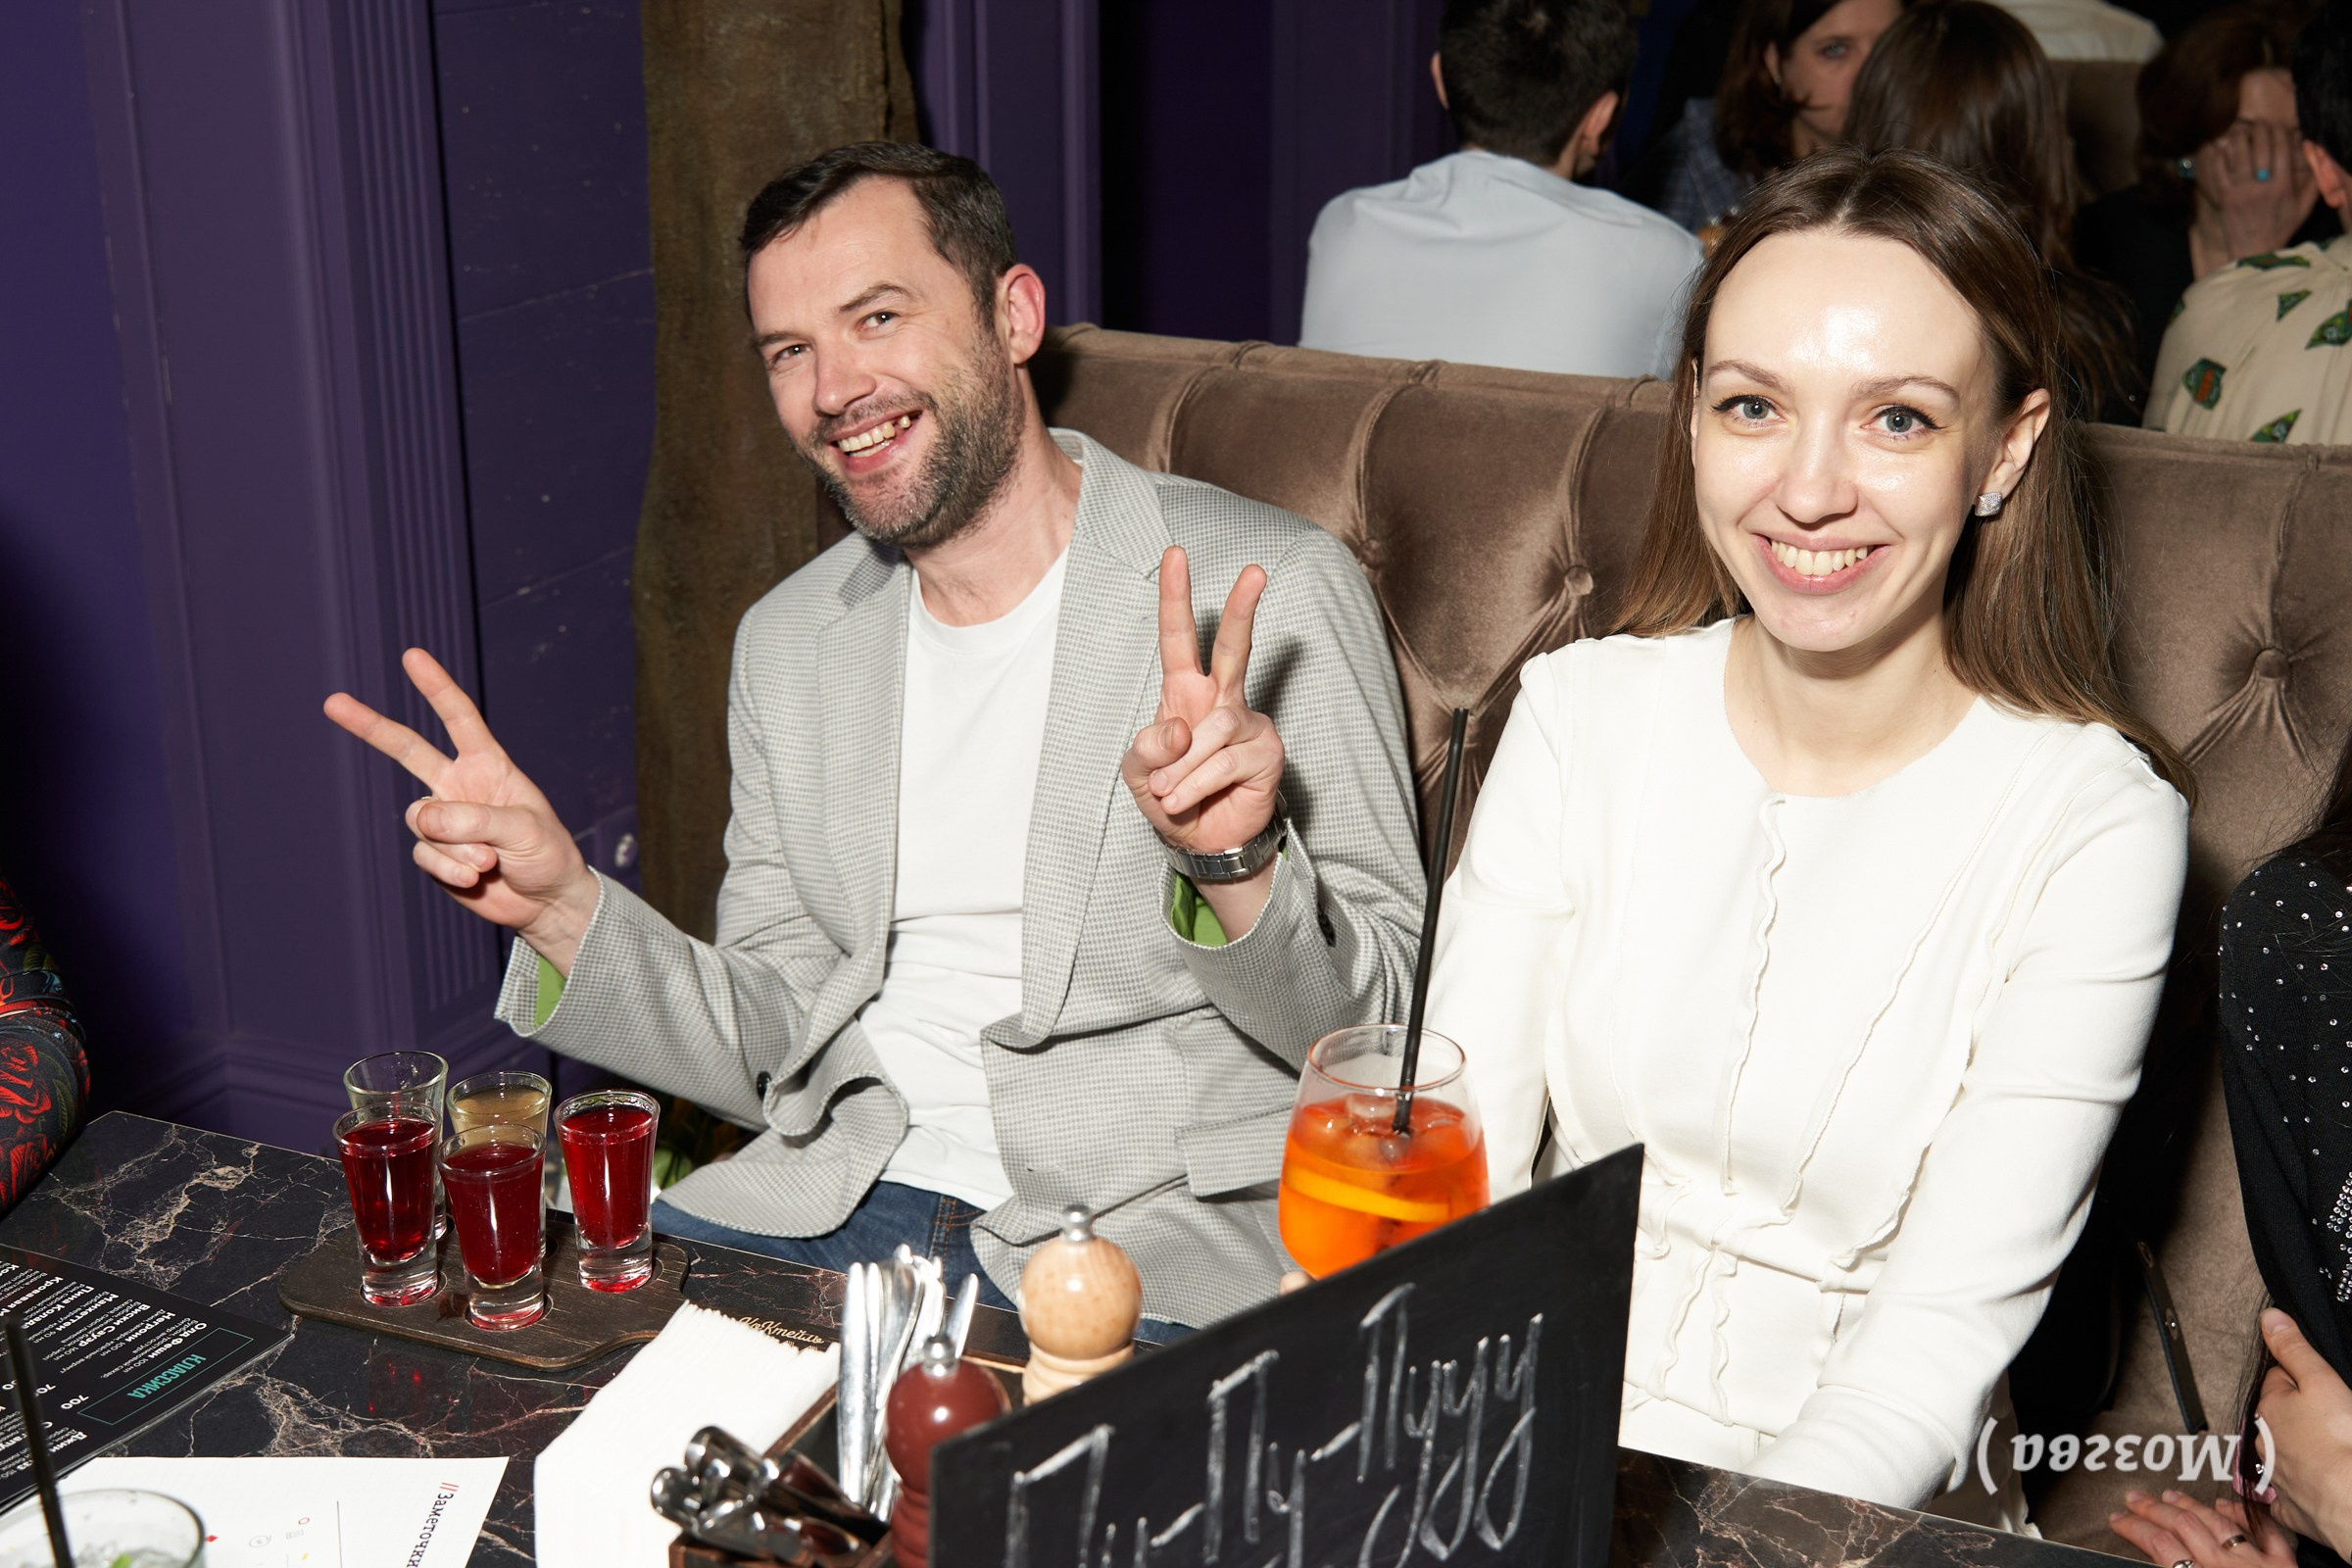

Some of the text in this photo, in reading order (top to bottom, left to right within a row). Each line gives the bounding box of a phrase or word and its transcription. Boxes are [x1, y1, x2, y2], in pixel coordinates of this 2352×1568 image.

[7, 1276, 64, 1308] Кровавая
[21, 1285, 94, 1329] Пина Колада
[55, 1293, 119, 1331] Манхеттен
[113, 1303, 151, 1326] Виски
[78, 1325, 116, 1347] Сауэр
[124, 1310, 175, 1342] Негрони
[178, 1322, 207, 1338] Олд
[110, 1342, 125, 1350] 100
[147, 1337, 183, 1358] Фешн
[132, 1357, 149, 1367] 100
[126, 1353, 207, 1398] КЛАССИКА
[60, 1395, 89, 1409] 700
[49, 1431, 87, 1452] Джин
